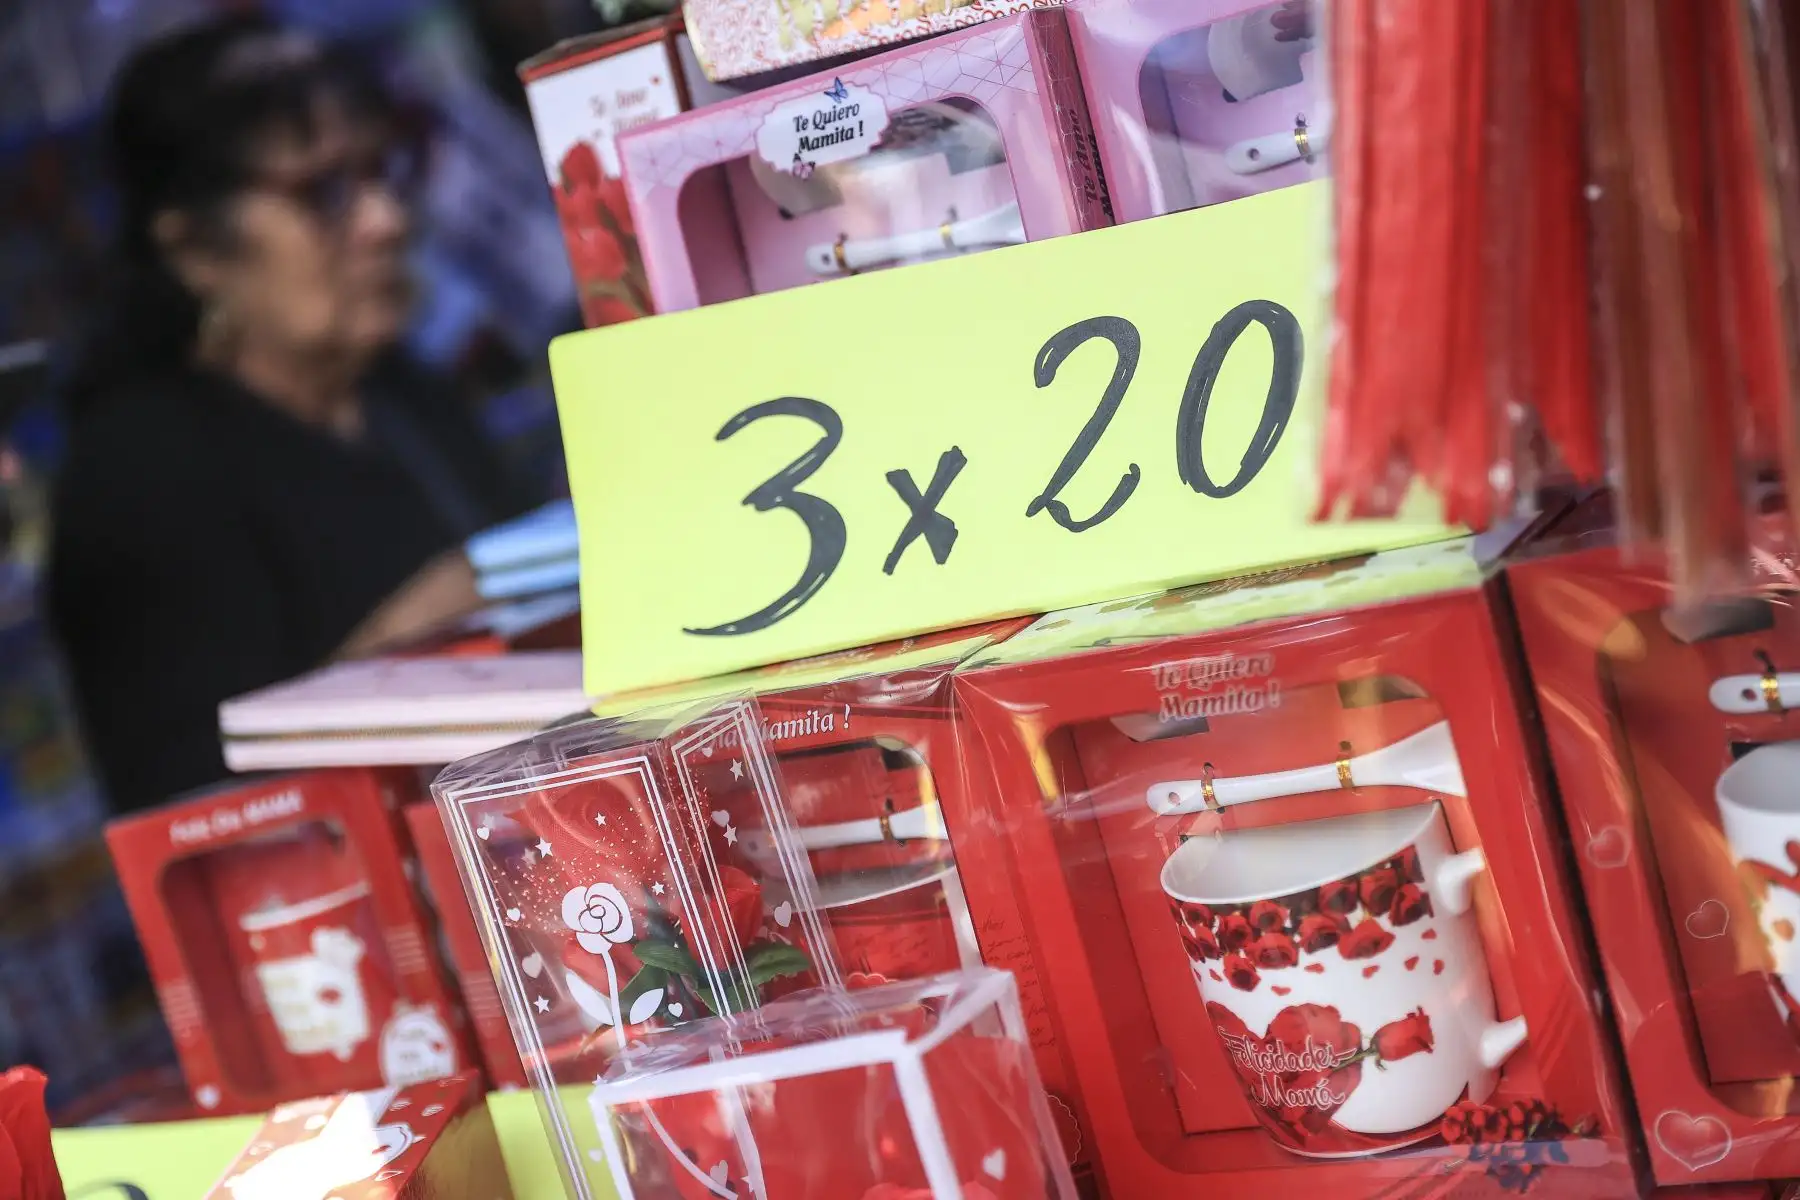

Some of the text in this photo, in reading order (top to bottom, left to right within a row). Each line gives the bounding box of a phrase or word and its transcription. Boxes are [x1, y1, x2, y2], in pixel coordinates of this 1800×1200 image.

[793, 101, 860, 133] Te Quiero
[683, 397, 847, 637] 3
[1025, 299, 1305, 533] 20
[1152, 652, 1276, 692] Te Quiero
[1218, 1025, 1358, 1073] Felicidades
